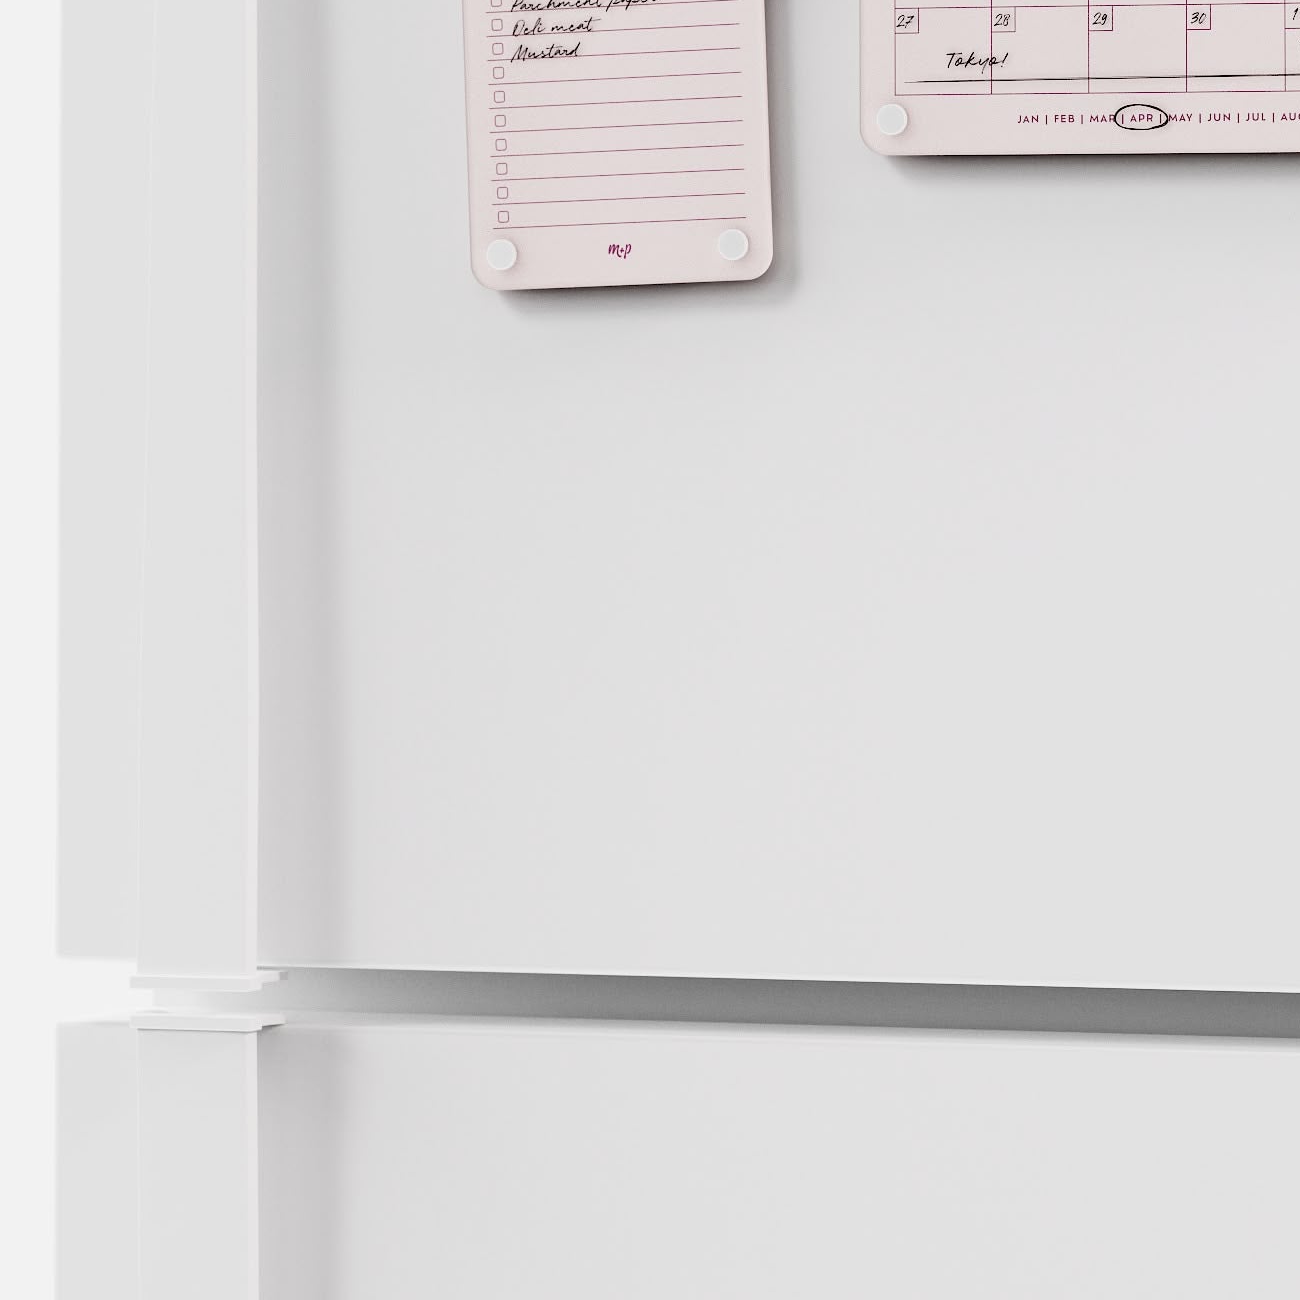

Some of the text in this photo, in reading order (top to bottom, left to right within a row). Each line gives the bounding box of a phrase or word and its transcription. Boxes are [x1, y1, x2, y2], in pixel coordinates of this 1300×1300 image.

[994, 14, 1010, 26] 28
[1092, 12, 1107, 25] 29
[1191, 12, 1207, 24] 30
[1292, 8, 1299, 20] 1
[512, 17, 601, 37] Deli meat
[896, 15, 914, 28] 27
[510, 43, 581, 62] Mustard
[946, 52, 1008, 74] Tokyo!
[1018, 114, 1040, 124] JAN
[1054, 114, 1075, 123] FEB
[1090, 114, 1116, 123] MAR
[1130, 113, 1153, 123] APR
[1168, 113, 1193, 122] MAY
[1207, 113, 1231, 122] JUN
[1246, 112, 1266, 122] JUL
